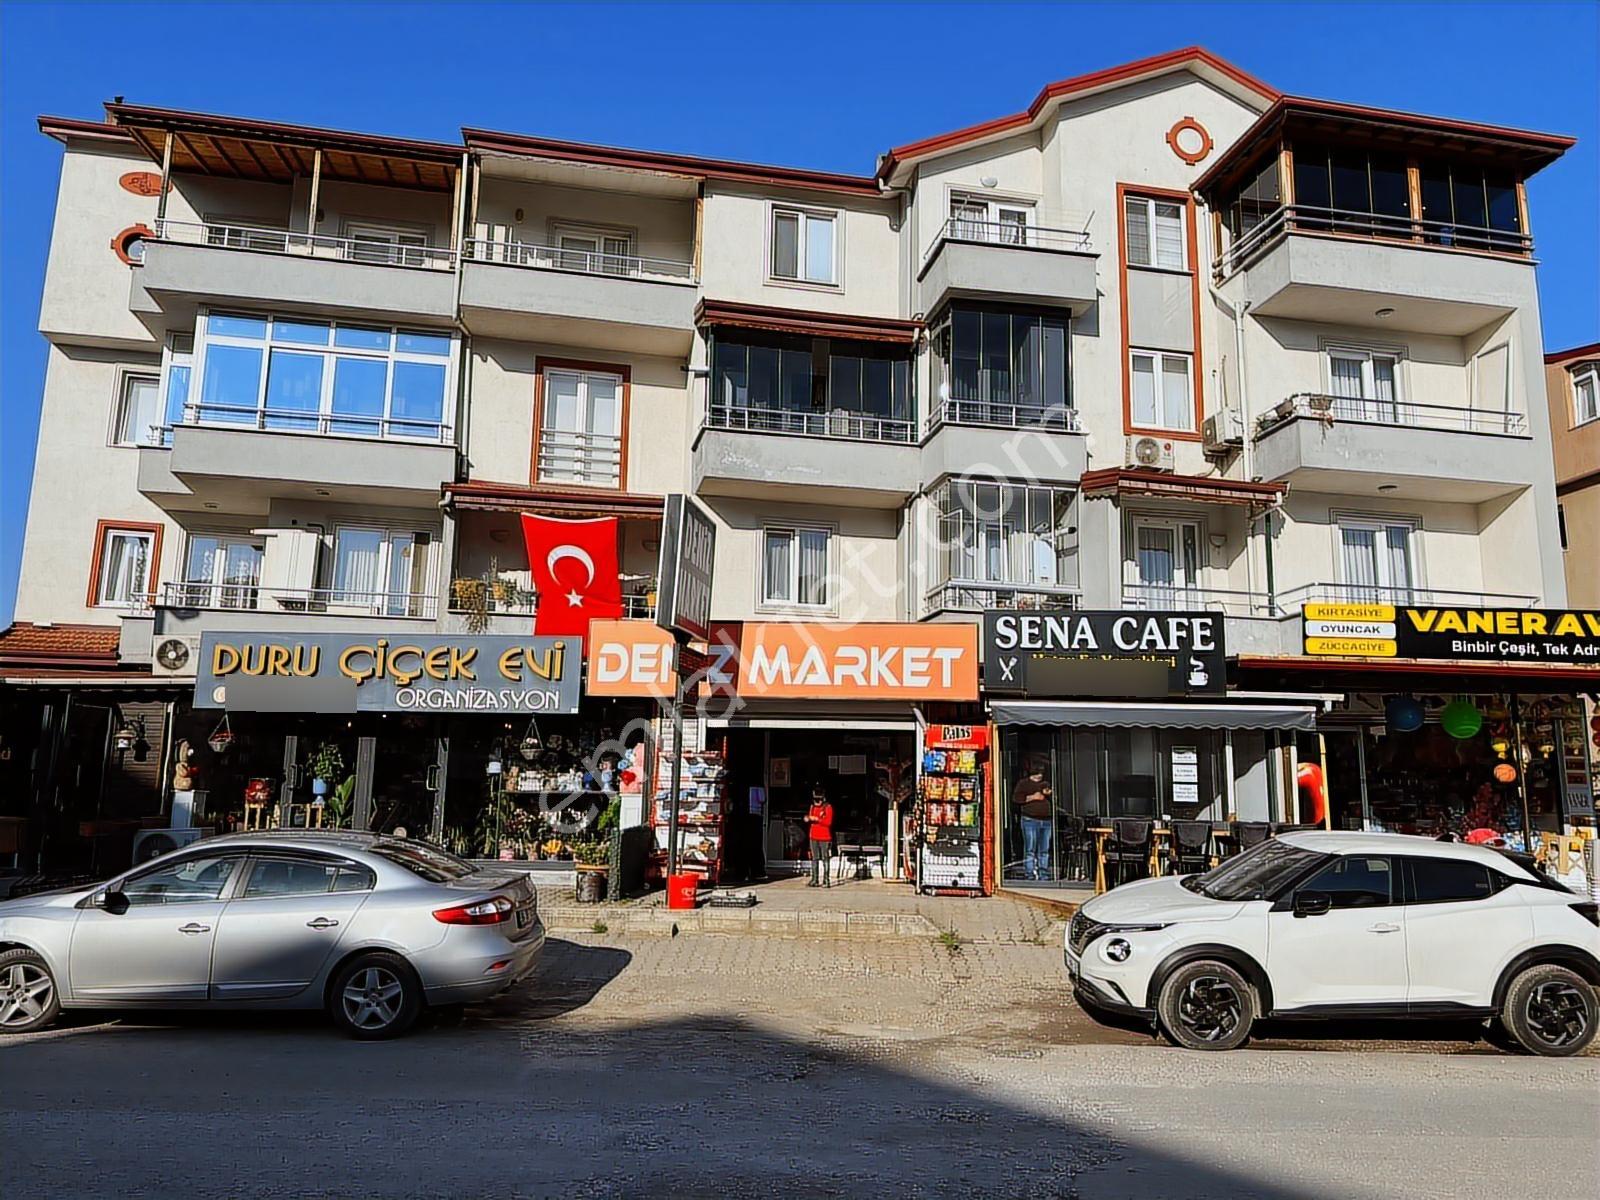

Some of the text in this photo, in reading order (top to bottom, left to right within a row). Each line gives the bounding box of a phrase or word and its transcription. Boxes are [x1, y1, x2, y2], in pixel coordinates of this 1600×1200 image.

[1317, 605, 1383, 617] KIRTASİYE
[994, 615, 1215, 652] SENA CAFE
[1320, 624, 1381, 634] OYUNCAK
[1452, 640, 1496, 653] Binbir
[1498, 641, 1540, 656] Çeşit,
[1543, 643, 1569, 655] Tek
[212, 642, 320, 677] DURU
[338, 637, 478, 686] ÇİÇEK
[747, 644, 965, 687] MARKET
[396, 686, 560, 710] ORGANİZASYON
